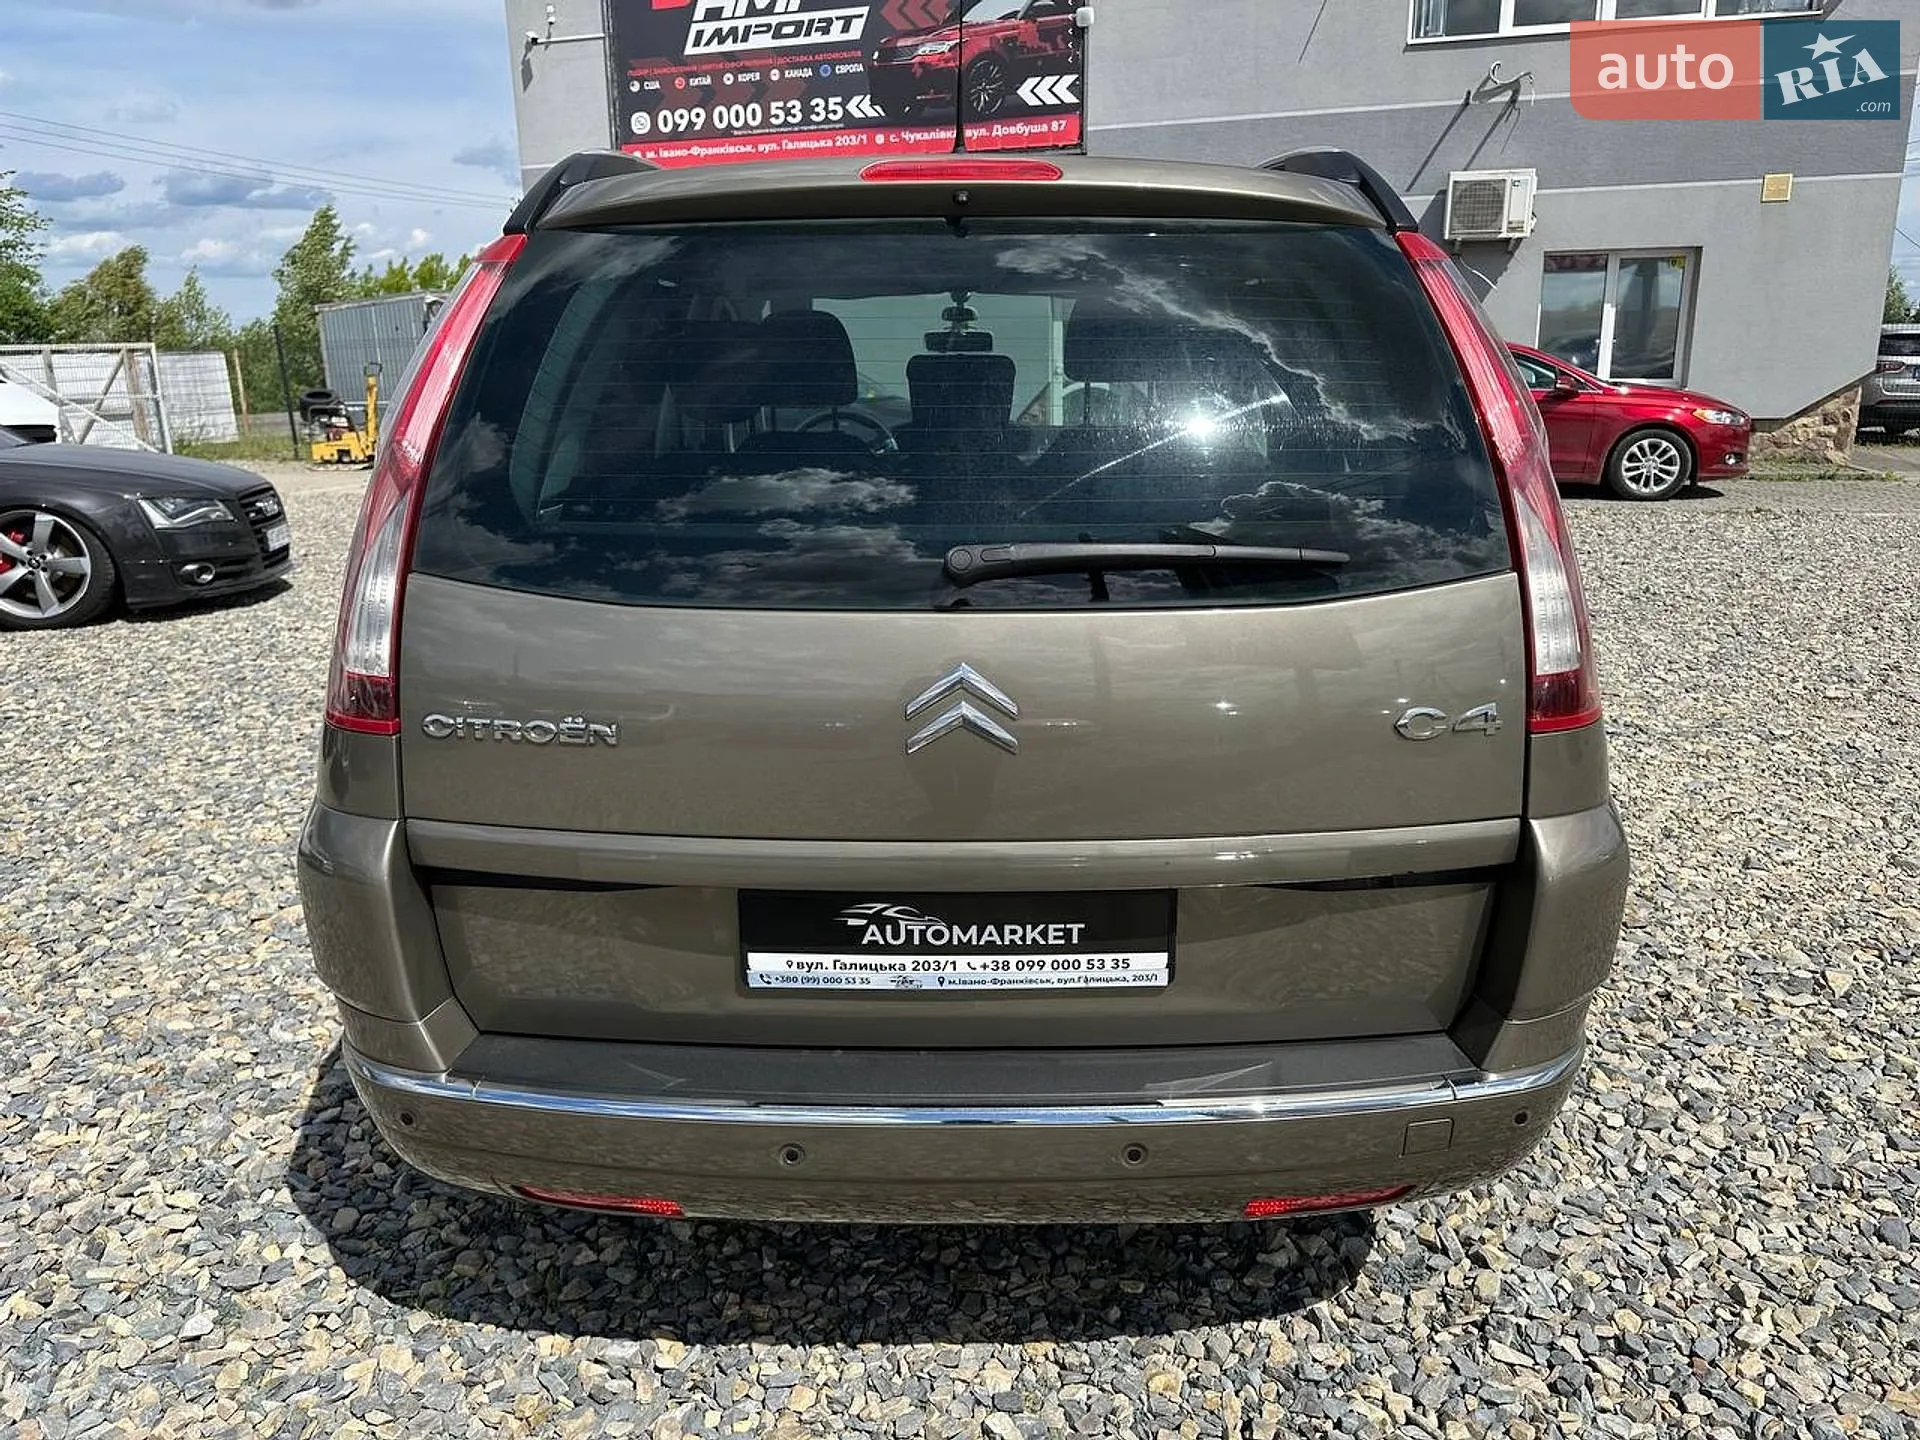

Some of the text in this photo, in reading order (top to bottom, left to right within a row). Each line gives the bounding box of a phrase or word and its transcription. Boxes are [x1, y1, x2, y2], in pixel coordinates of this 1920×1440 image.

[691, 13, 864, 49] IMPORT
[784, 67, 813, 78] КАНАДА
[835, 63, 864, 74] ЄВРОПА
[657, 107, 706, 133] 099
[712, 103, 762, 129] 000
[769, 100, 803, 125] 53
[809, 96, 844, 122] 35
[901, 128, 957, 144] Чукалівк
[965, 128, 990, 139] вул.
[991, 122, 1048, 137] Довбуша
[1051, 120, 1067, 131] 87
[782, 139, 833, 152] Галицька
[835, 134, 867, 147] 203/1
[422, 713, 618, 746] CITROËN
[861, 922, 1086, 946] AUTOMARKET
[797, 959, 957, 973] вул. Галицька 203/1
[980, 958, 1131, 972] +38 099 000 53 35
[774, 976, 871, 986] +380 (99) 000 53 35
[1132, 972, 1158, 983] 203/1
